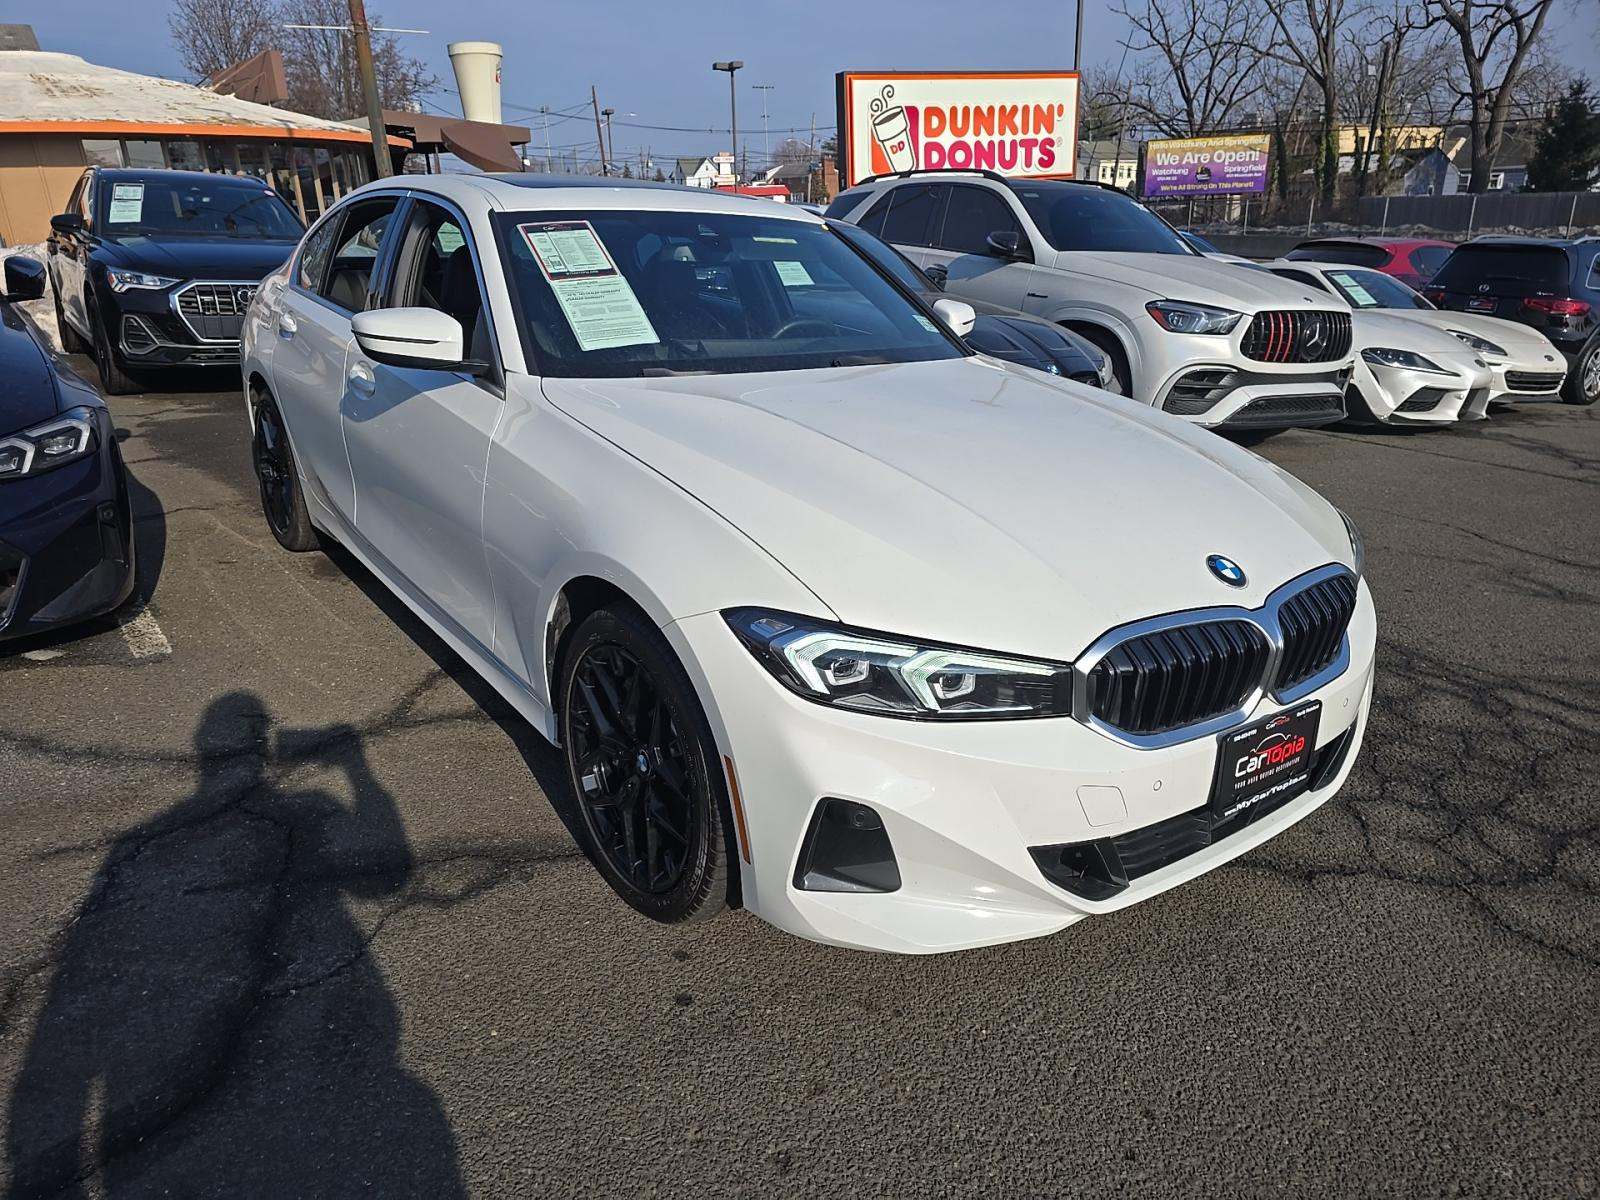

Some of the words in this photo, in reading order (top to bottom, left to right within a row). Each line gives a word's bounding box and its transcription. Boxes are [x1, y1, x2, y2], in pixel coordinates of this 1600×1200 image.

[924, 103, 1065, 138] DUNKIN'
[890, 141, 906, 155] DD
[924, 138, 1056, 170] DONUTS
[1156, 152, 1180, 166] We
[1182, 151, 1211, 164] Are
[1213, 148, 1260, 165] Open!
[1152, 168, 1189, 176] Watchung
[1224, 164, 1267, 173] Springfield
[1235, 735, 1305, 778] CarTopia
